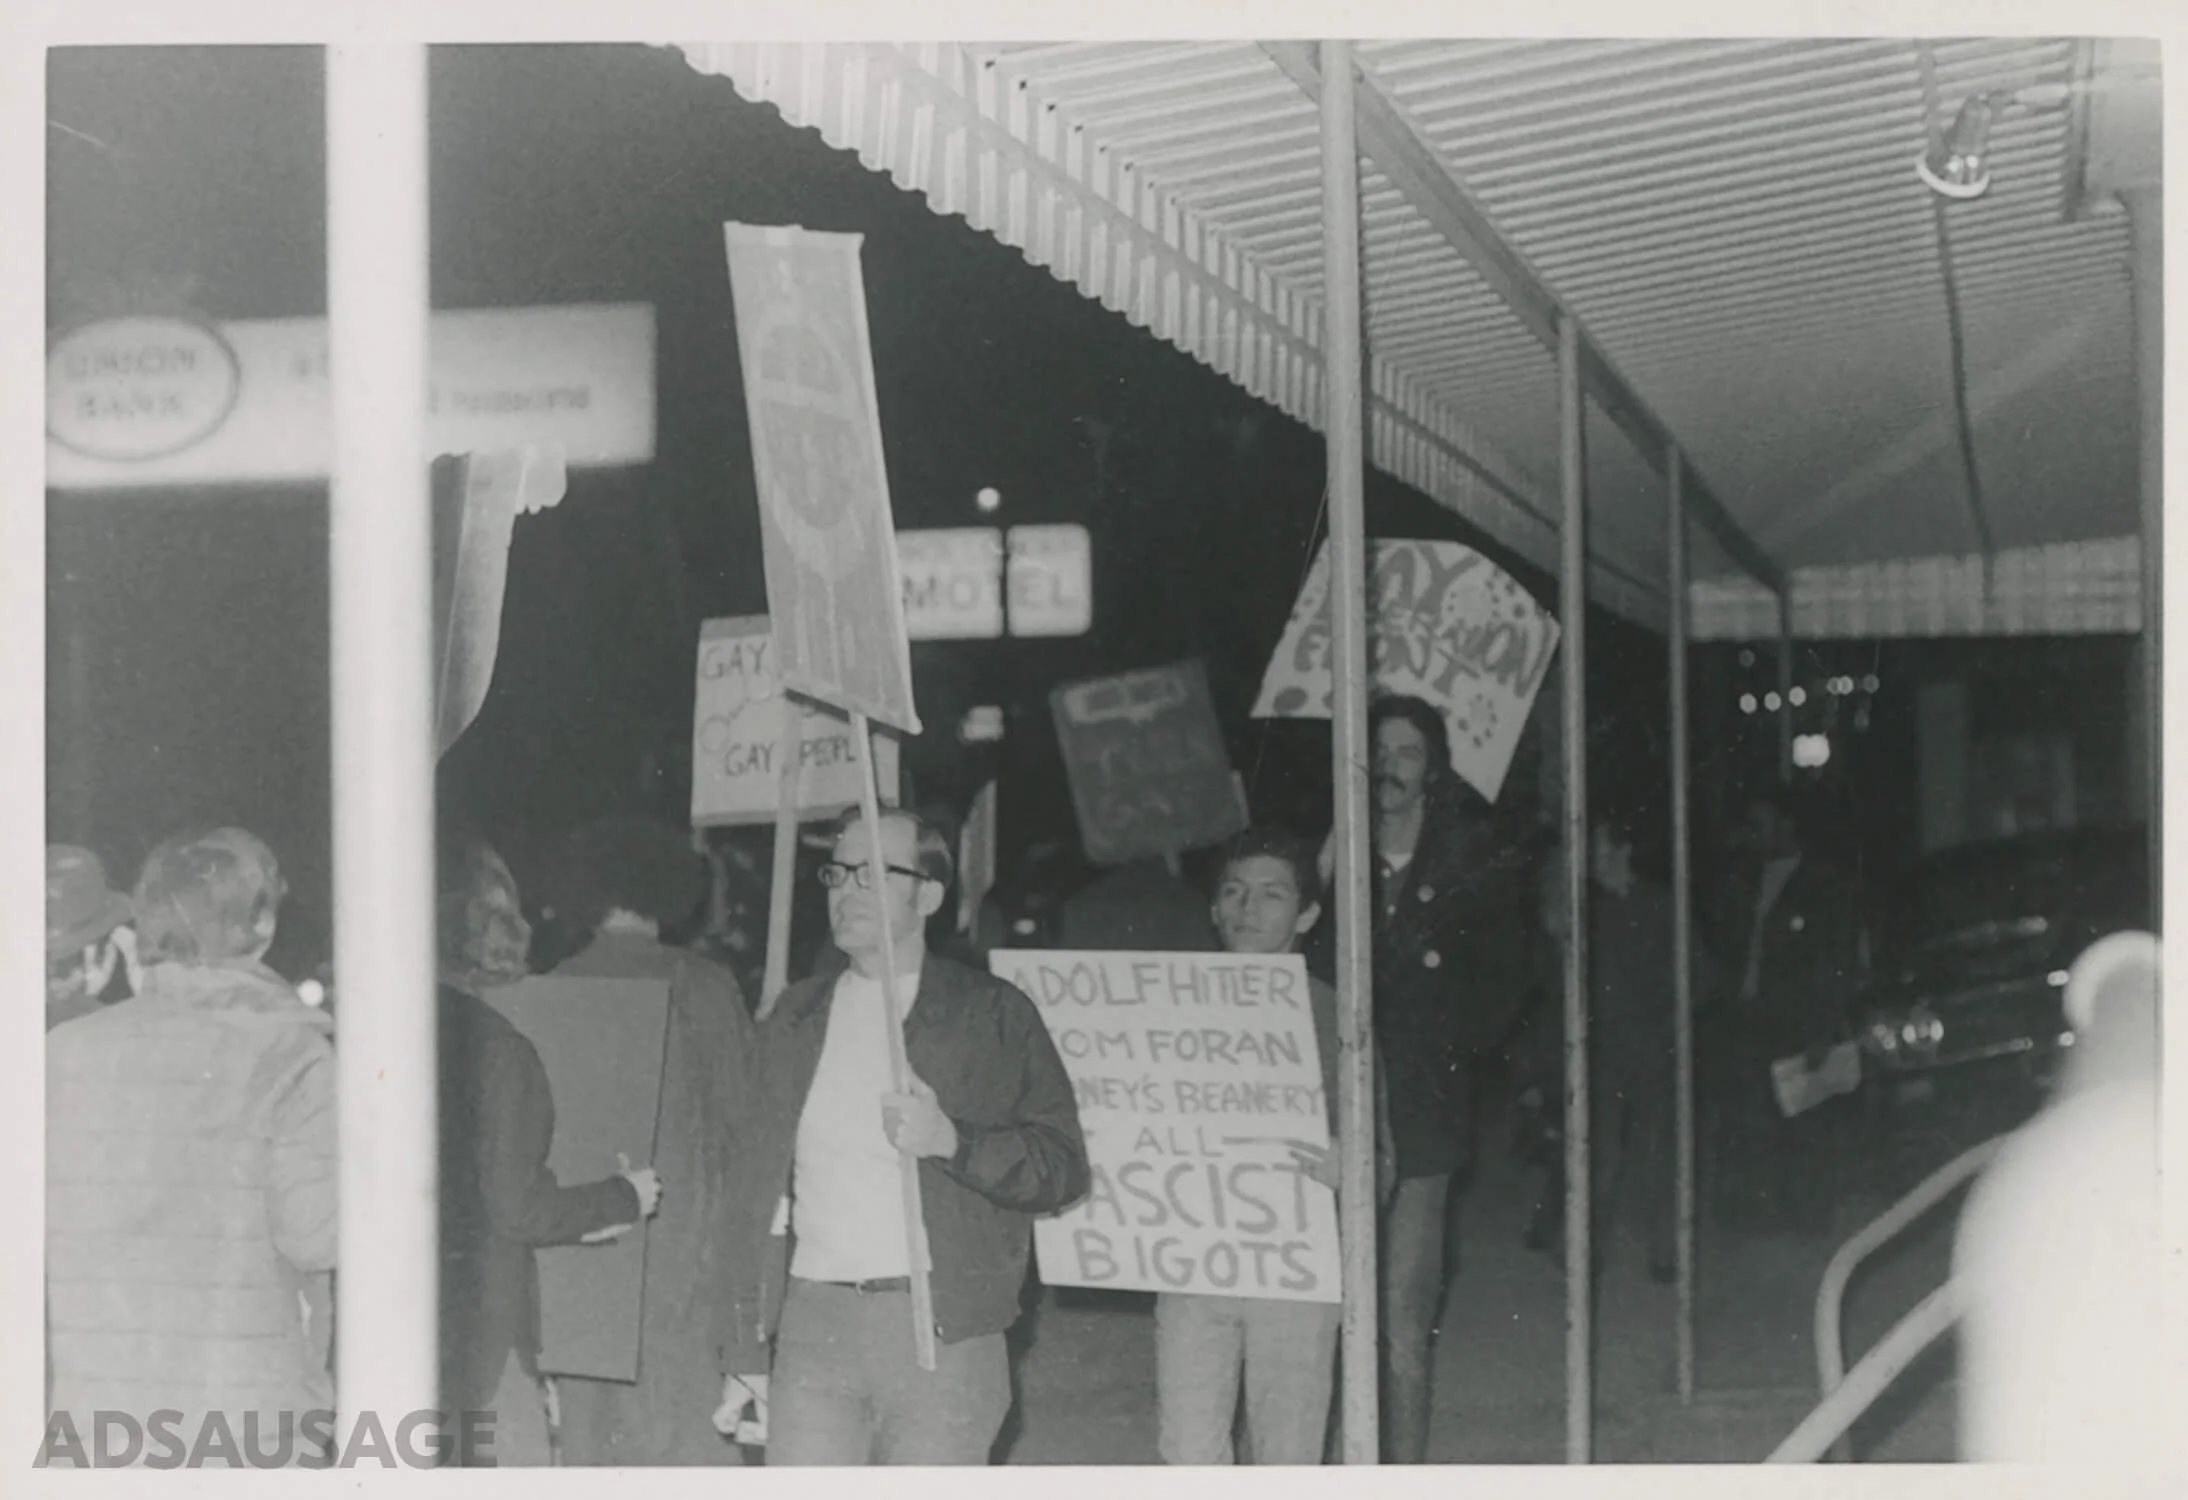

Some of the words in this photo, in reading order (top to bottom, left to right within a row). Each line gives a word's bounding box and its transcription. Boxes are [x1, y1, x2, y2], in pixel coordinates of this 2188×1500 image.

[902, 569, 1087, 612] MOEL
[703, 641, 768, 680] GAY
[724, 740, 776, 777] GAY
[1012, 960, 1162, 1009] ADOLF
[1166, 961, 1301, 1010] HITLER
[1049, 1027, 1135, 1060] OM
[1145, 1027, 1303, 1067] FORAN
[1070, 1073, 1165, 1115] NEY'S
[1173, 1078, 1324, 1117] BEANERY
[1133, 1126, 1224, 1158] ALL
[1084, 1161, 1311, 1234] ASCIST
[1072, 1228, 1319, 1292] BIGOTS
